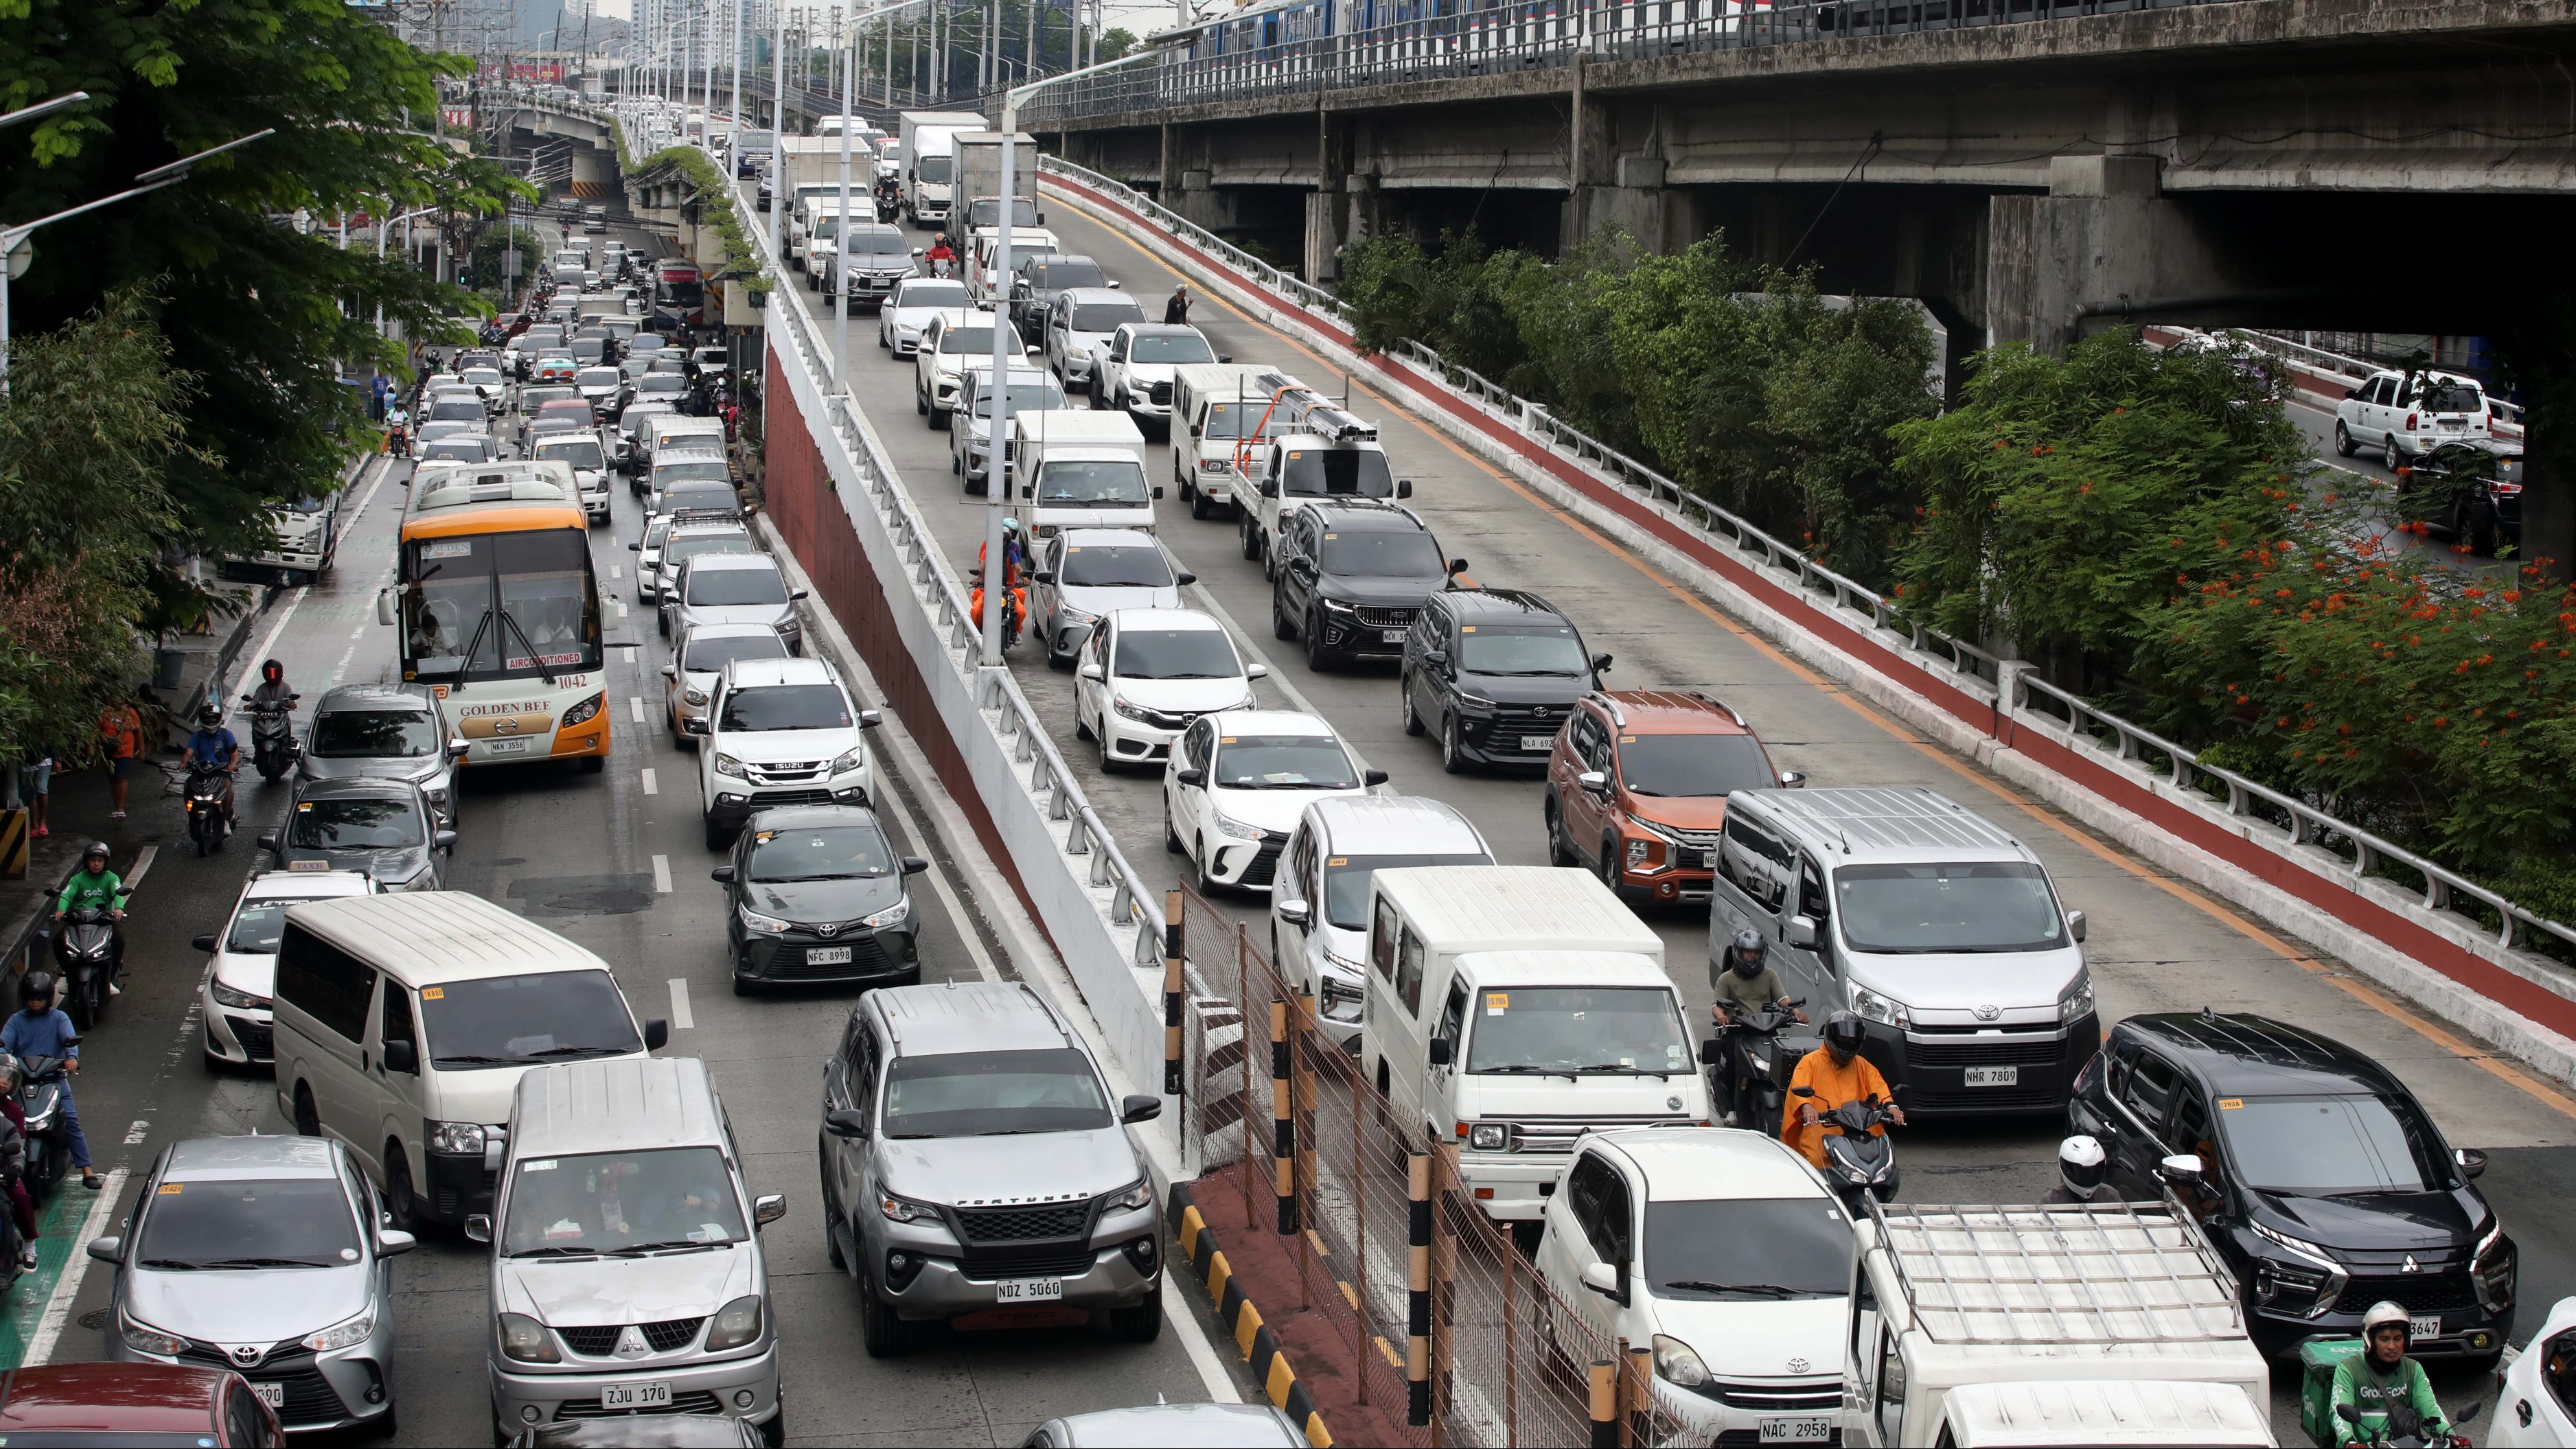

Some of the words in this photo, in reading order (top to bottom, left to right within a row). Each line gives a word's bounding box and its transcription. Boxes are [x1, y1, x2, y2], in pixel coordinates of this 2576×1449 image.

[424, 544, 469, 552] GOLDEN
[510, 653, 580, 669] AIRCONDITIONED
[559, 675, 587, 689] 1042
[461, 704, 520, 717] GOLDEN
[525, 701, 551, 712] BEE
[508, 741, 523, 750] 3556
[84, 888, 103, 898] Gab
[808, 951, 824, 962] NFC
[829, 949, 850, 960] 8998
[1966, 1071, 1984, 1082] NHR
[1992, 1070, 2015, 1082] 7809
[957, 1192, 1089, 1206] FORTUNER
[999, 1284, 1021, 1298] NDZ
[1029, 1282, 1059, 1296] 5060
[608, 1389, 632, 1404] ZJU
[641, 1387, 665, 1402] 170
[1762, 1424, 1786, 1438] NAC
[1795, 1423, 1827, 1437] 2958
